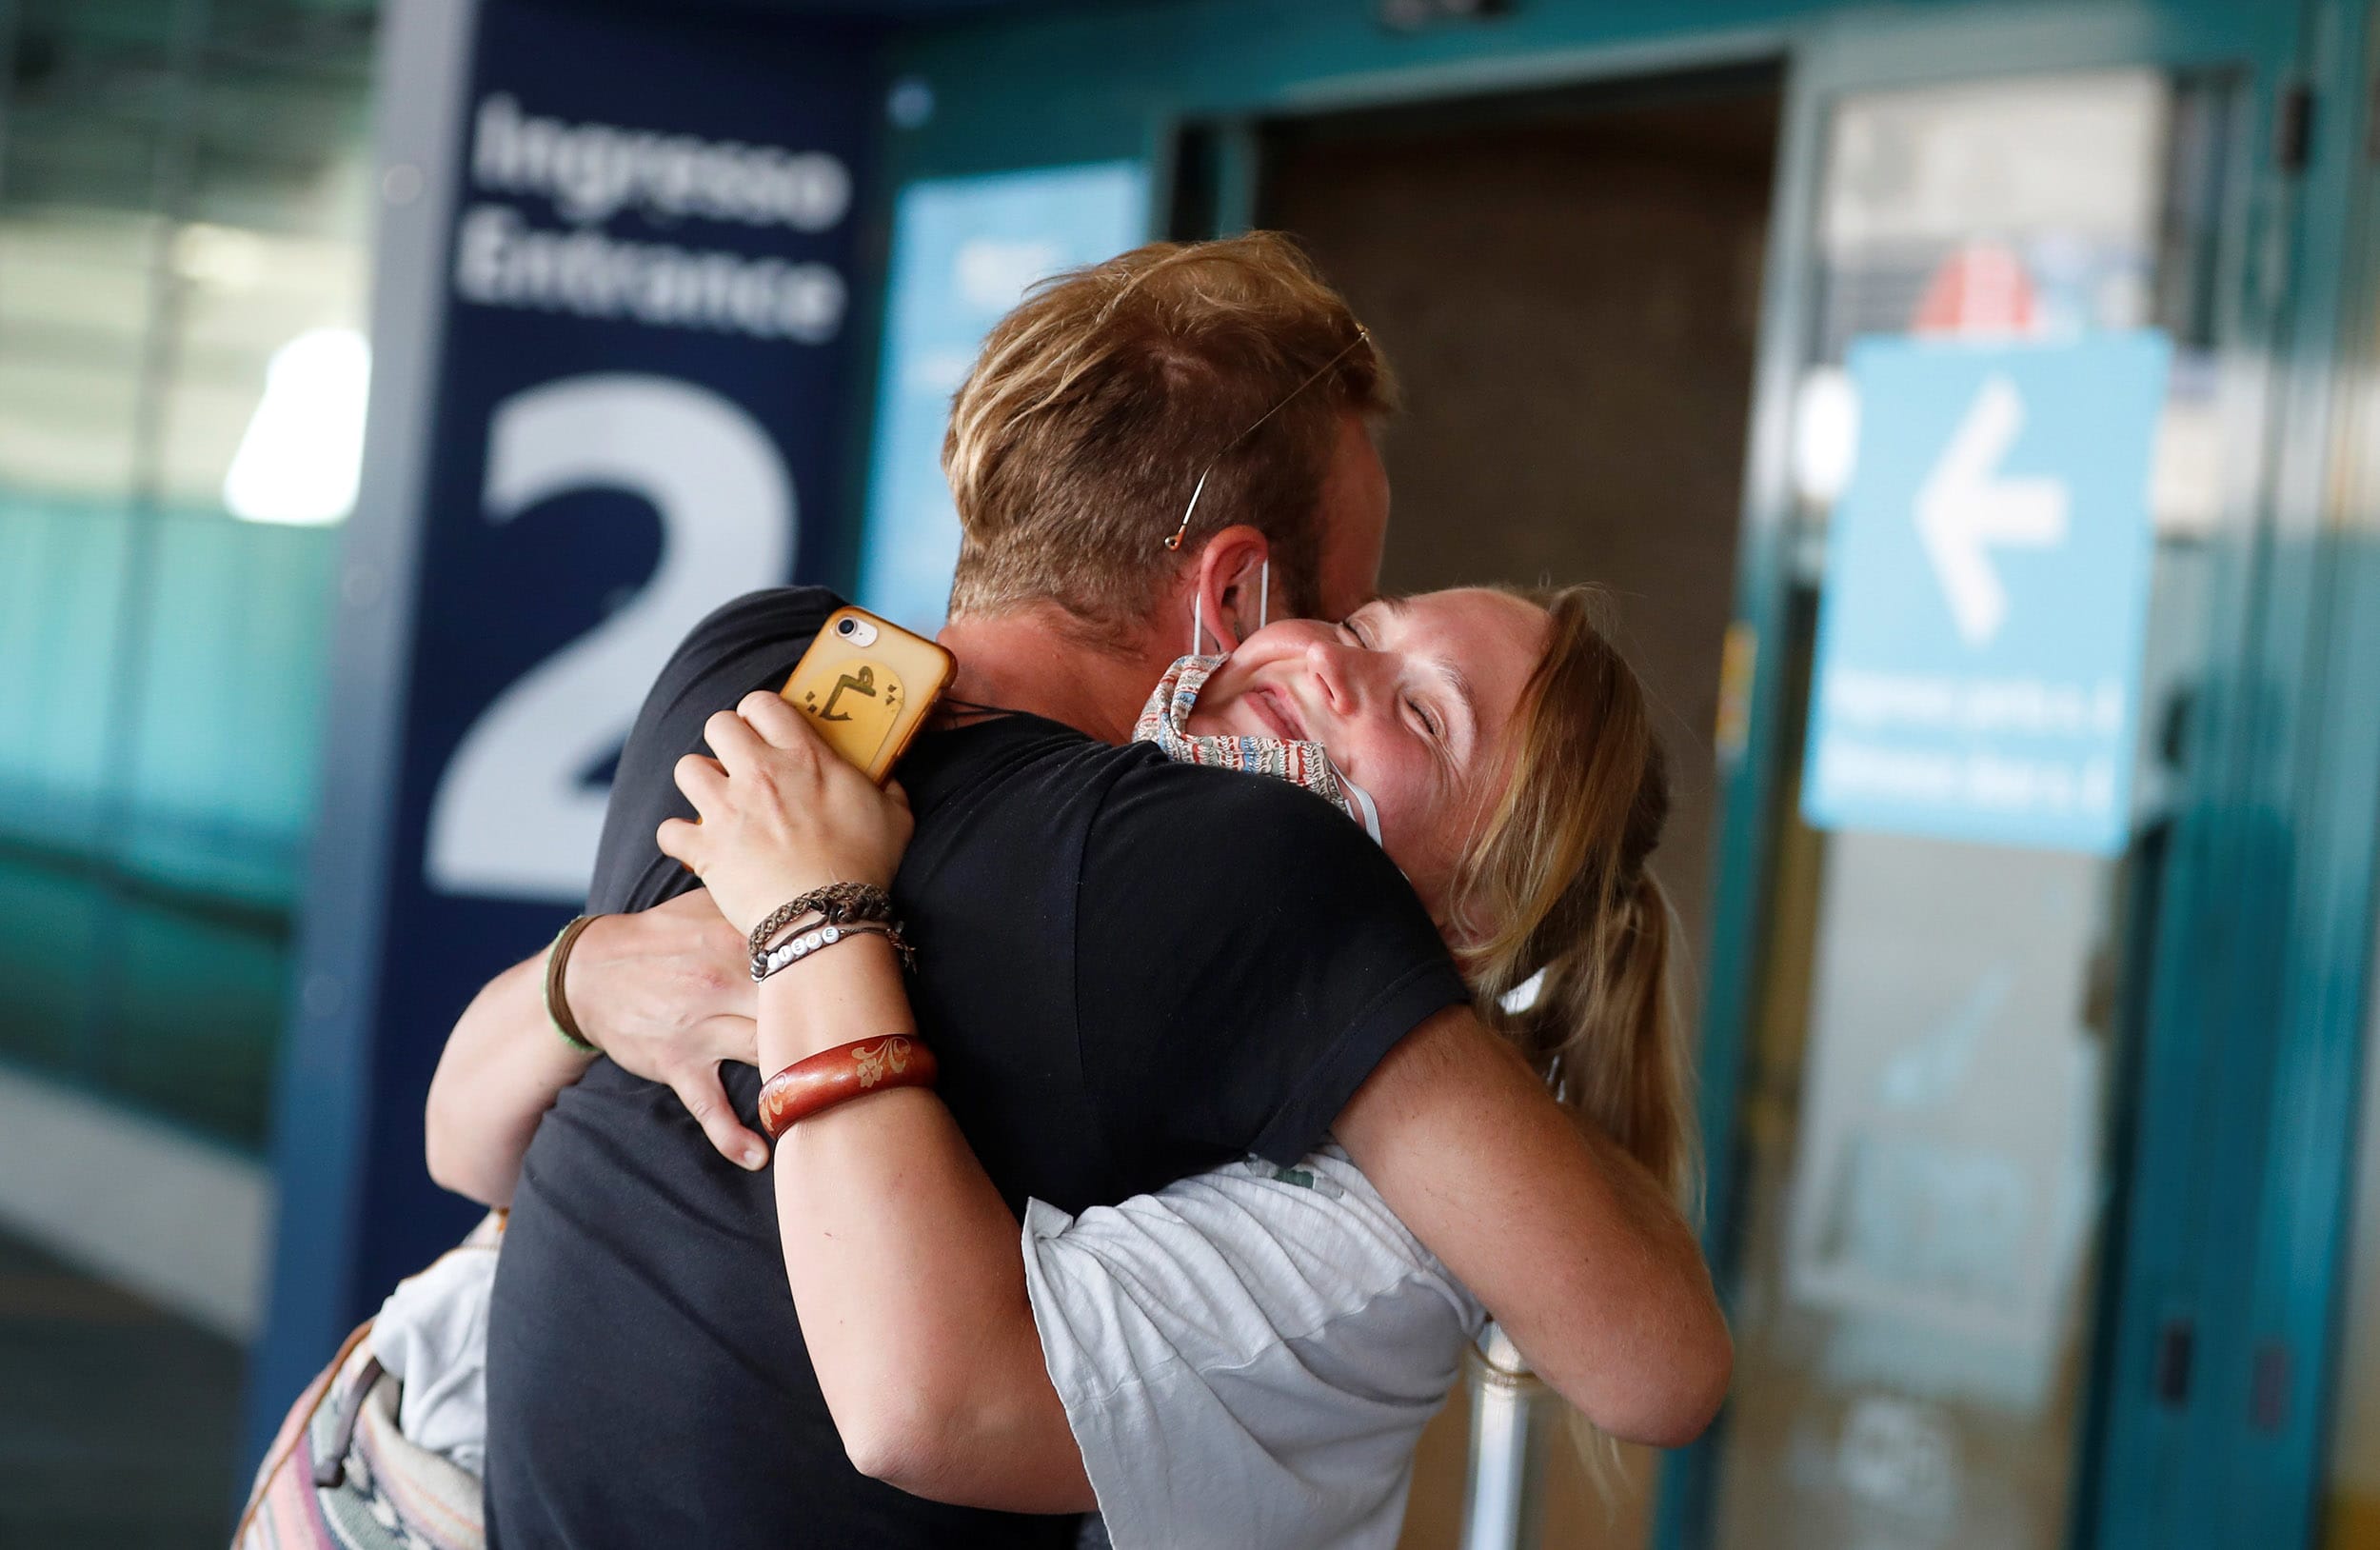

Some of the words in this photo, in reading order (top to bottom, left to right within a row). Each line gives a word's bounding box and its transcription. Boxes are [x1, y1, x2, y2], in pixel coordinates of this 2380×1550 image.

[478, 94, 848, 229] Ingresso
[458, 203, 846, 342] Entrance
[426, 373, 798, 900] 2
[769, 926, 838, 967] IEBE
